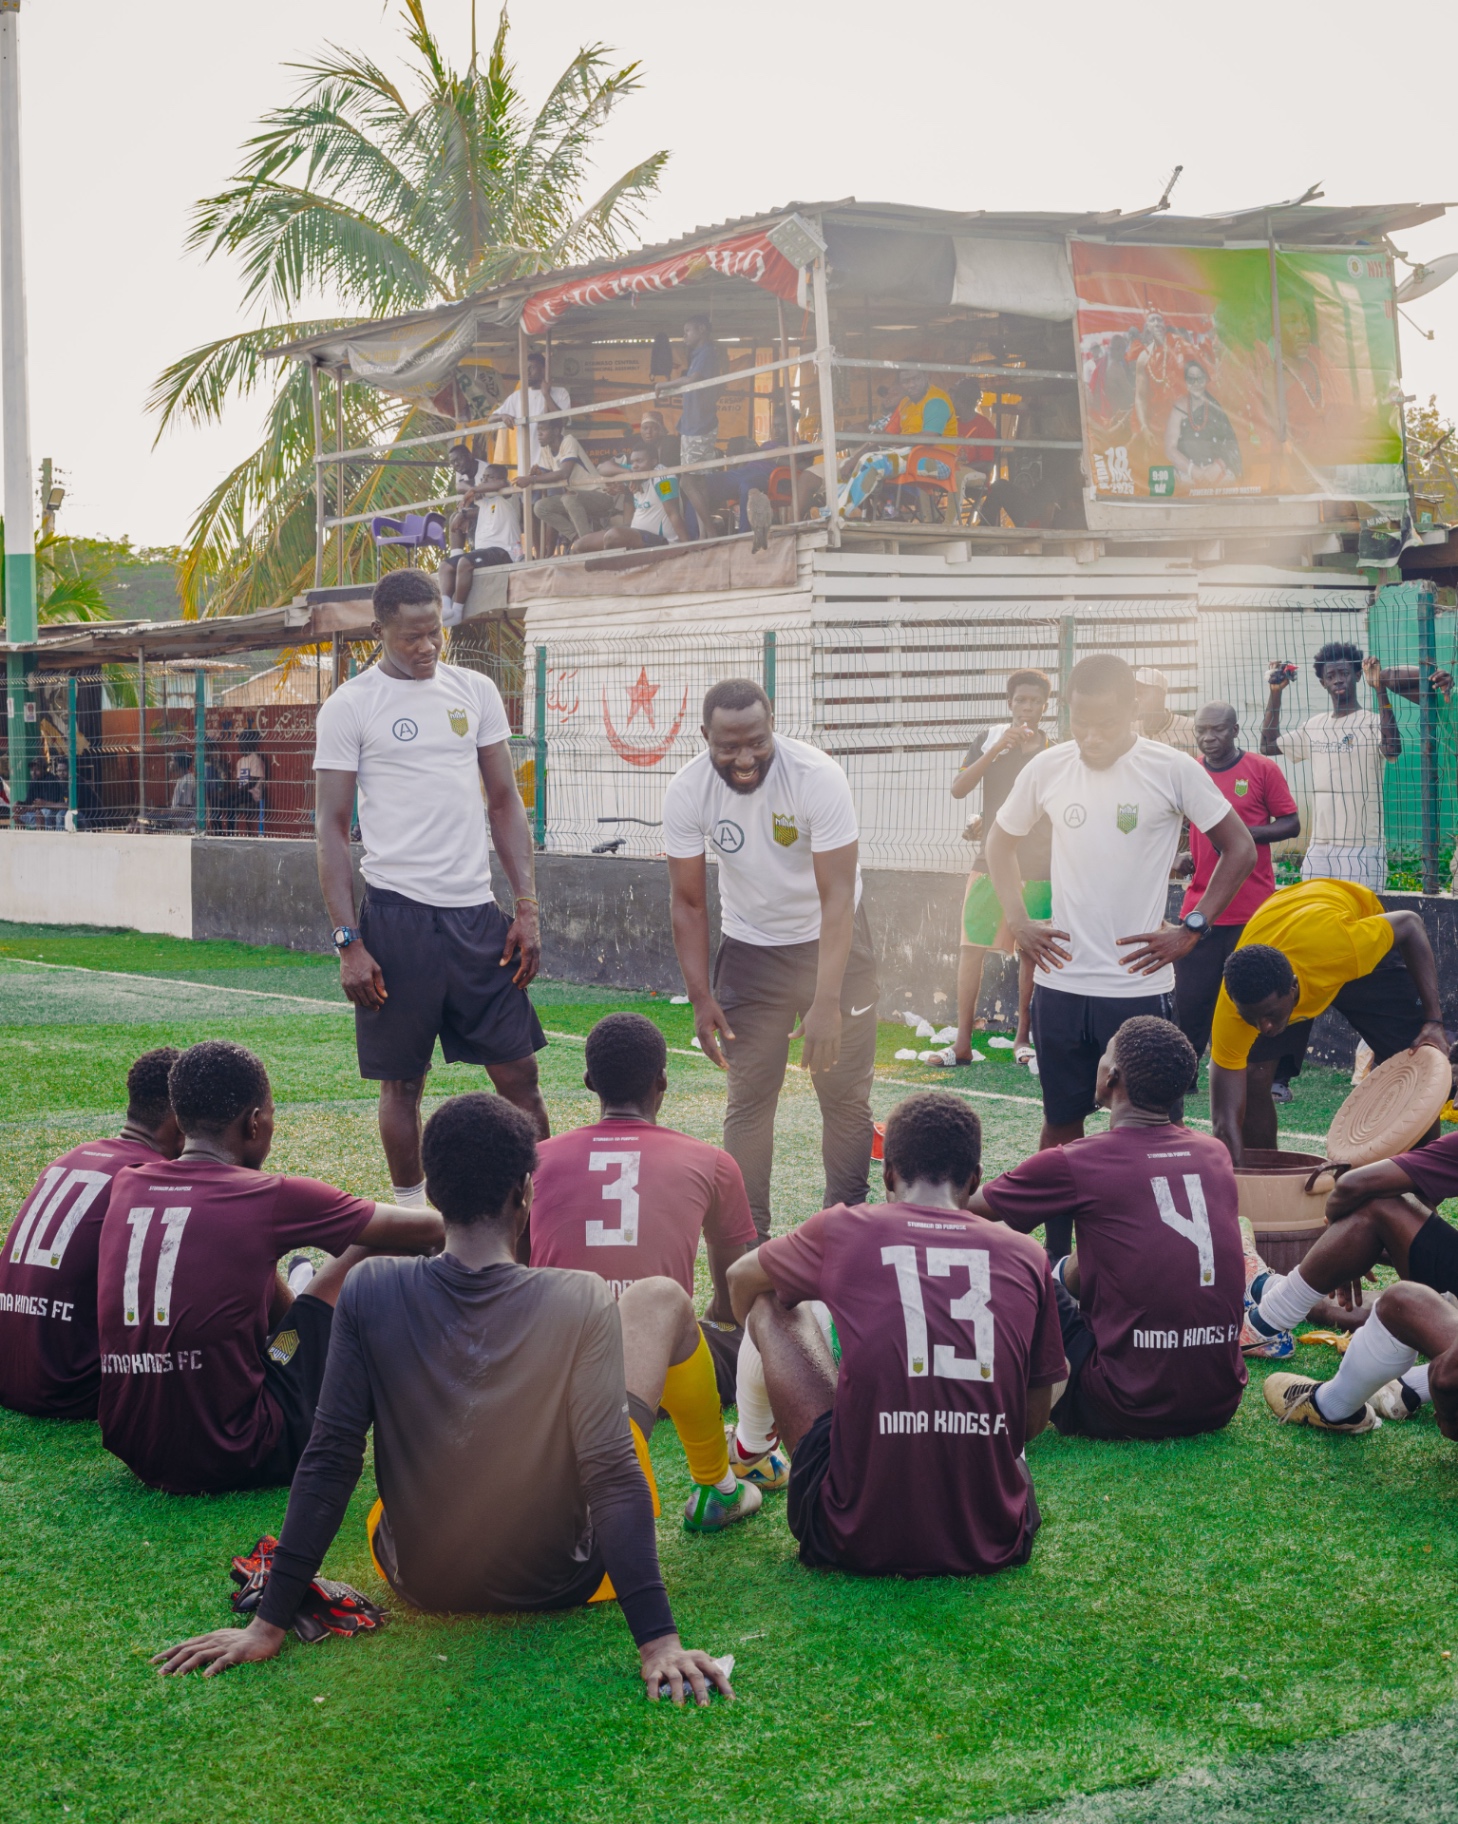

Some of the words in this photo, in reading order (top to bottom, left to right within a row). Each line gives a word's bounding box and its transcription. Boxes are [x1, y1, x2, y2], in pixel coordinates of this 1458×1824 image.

[9, 1166, 113, 1270] 10
[585, 1150, 641, 1247] 3
[1149, 1173, 1216, 1287] 4
[15, 1294, 49, 1316] KINGS
[51, 1300, 75, 1322] FC
[123, 1206, 192, 1327] 11
[880, 1245, 995, 1383] 13
[177, 1350, 203, 1371] FC
[1133, 1328, 1179, 1349] NIMA
[1182, 1325, 1225, 1348] KINGS
[879, 1411, 929, 1435] NIMA
[933, 1410, 991, 1437] KINGS
[993, 1412, 1009, 1436] F
